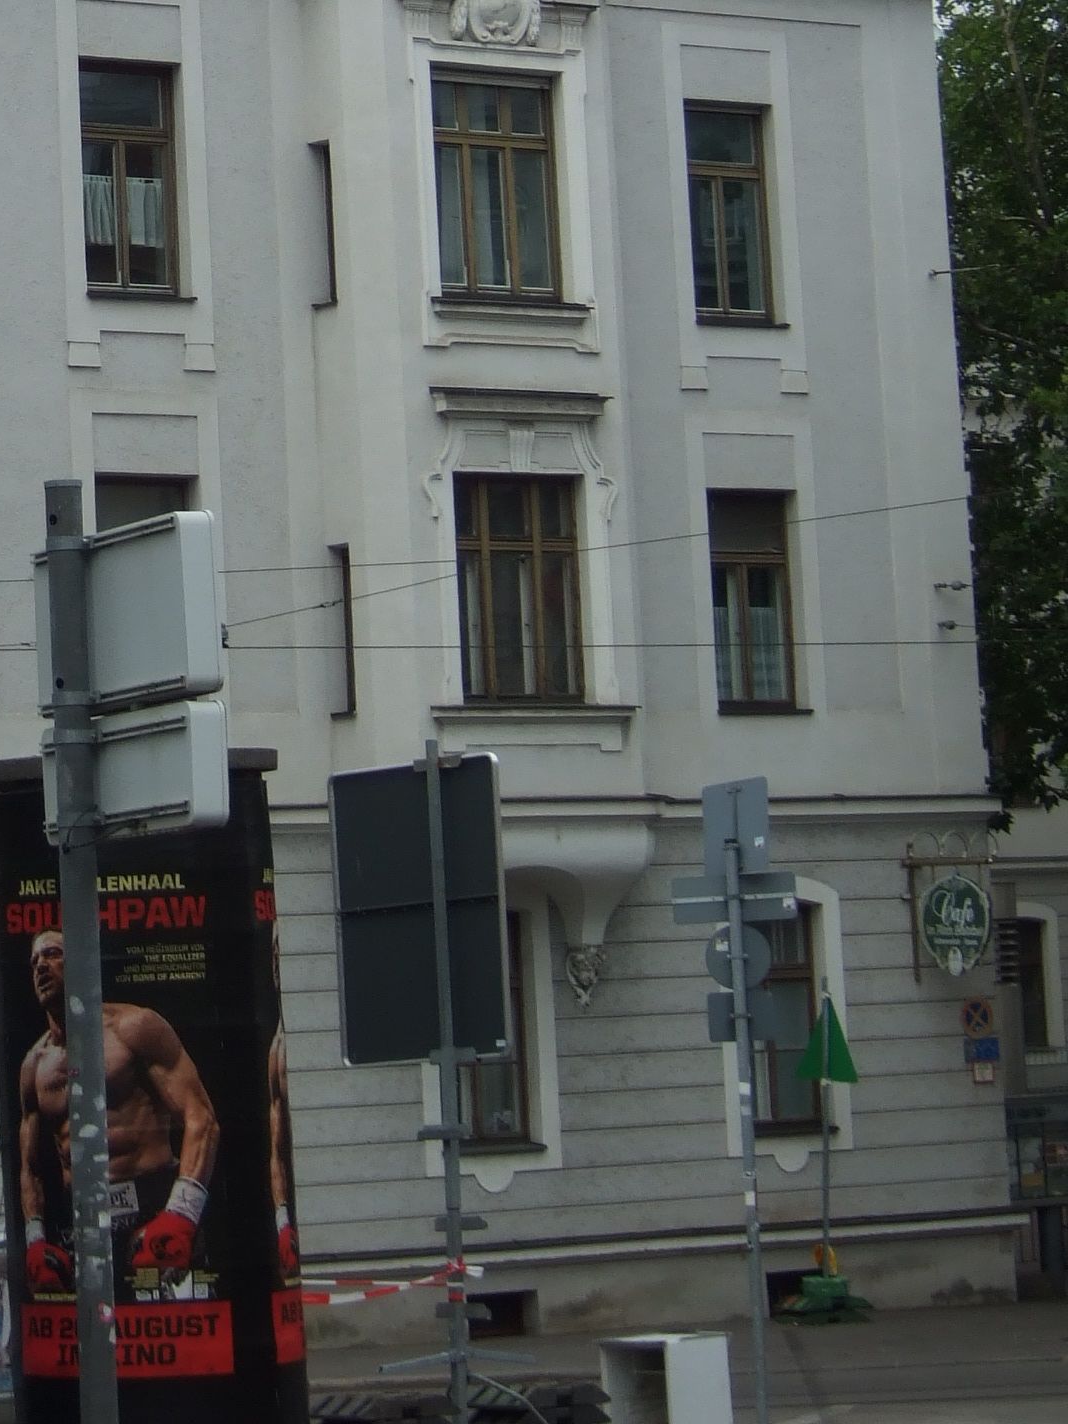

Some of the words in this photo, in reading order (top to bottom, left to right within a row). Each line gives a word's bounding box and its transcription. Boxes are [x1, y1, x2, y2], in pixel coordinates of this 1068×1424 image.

[18, 879, 56, 896] JAKE
[96, 873, 185, 893] LENHAAL
[6, 895, 207, 934] SOUHPAW
[144, 954, 160, 963] THE
[162, 953, 205, 962] EQUALIZER
[28, 1316, 53, 1338] AB
